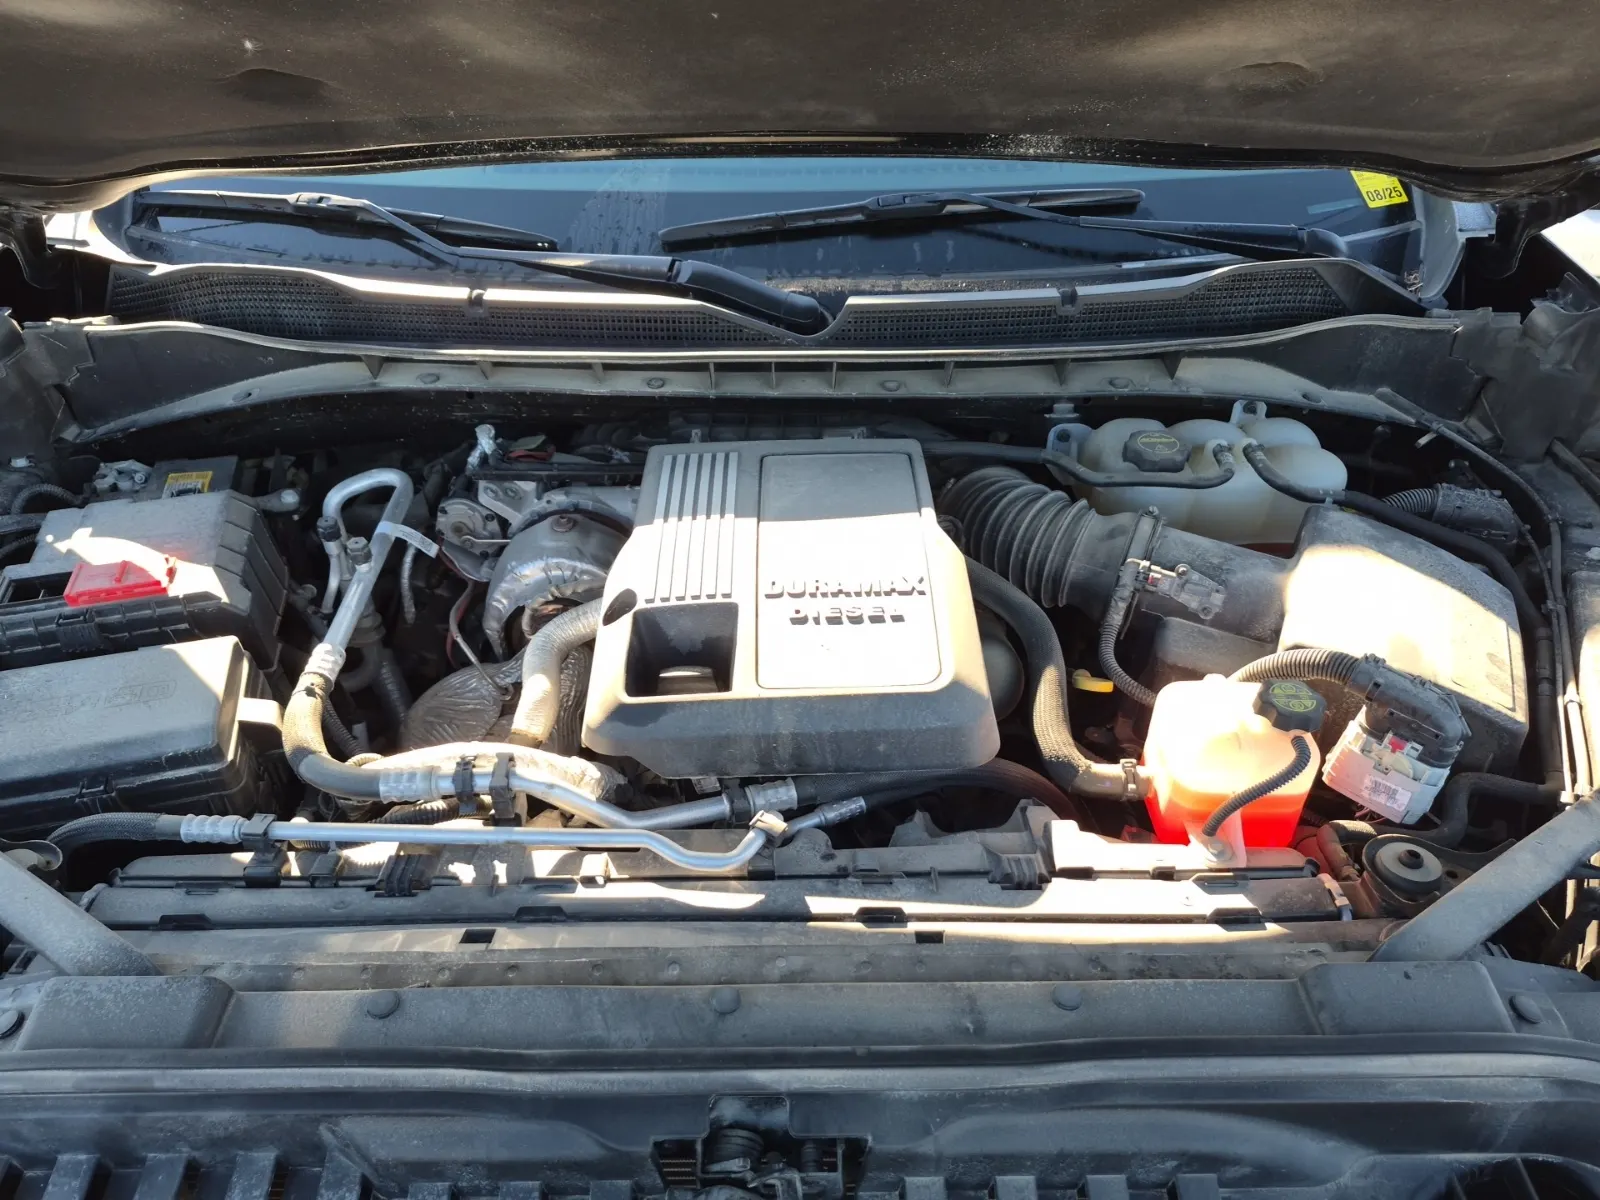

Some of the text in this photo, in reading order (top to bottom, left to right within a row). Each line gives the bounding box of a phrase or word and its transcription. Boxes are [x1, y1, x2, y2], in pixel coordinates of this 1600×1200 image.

[1366, 186, 1402, 202] 08/25
[764, 576, 926, 599] DURAMAX
[789, 606, 905, 625] DIESEL
